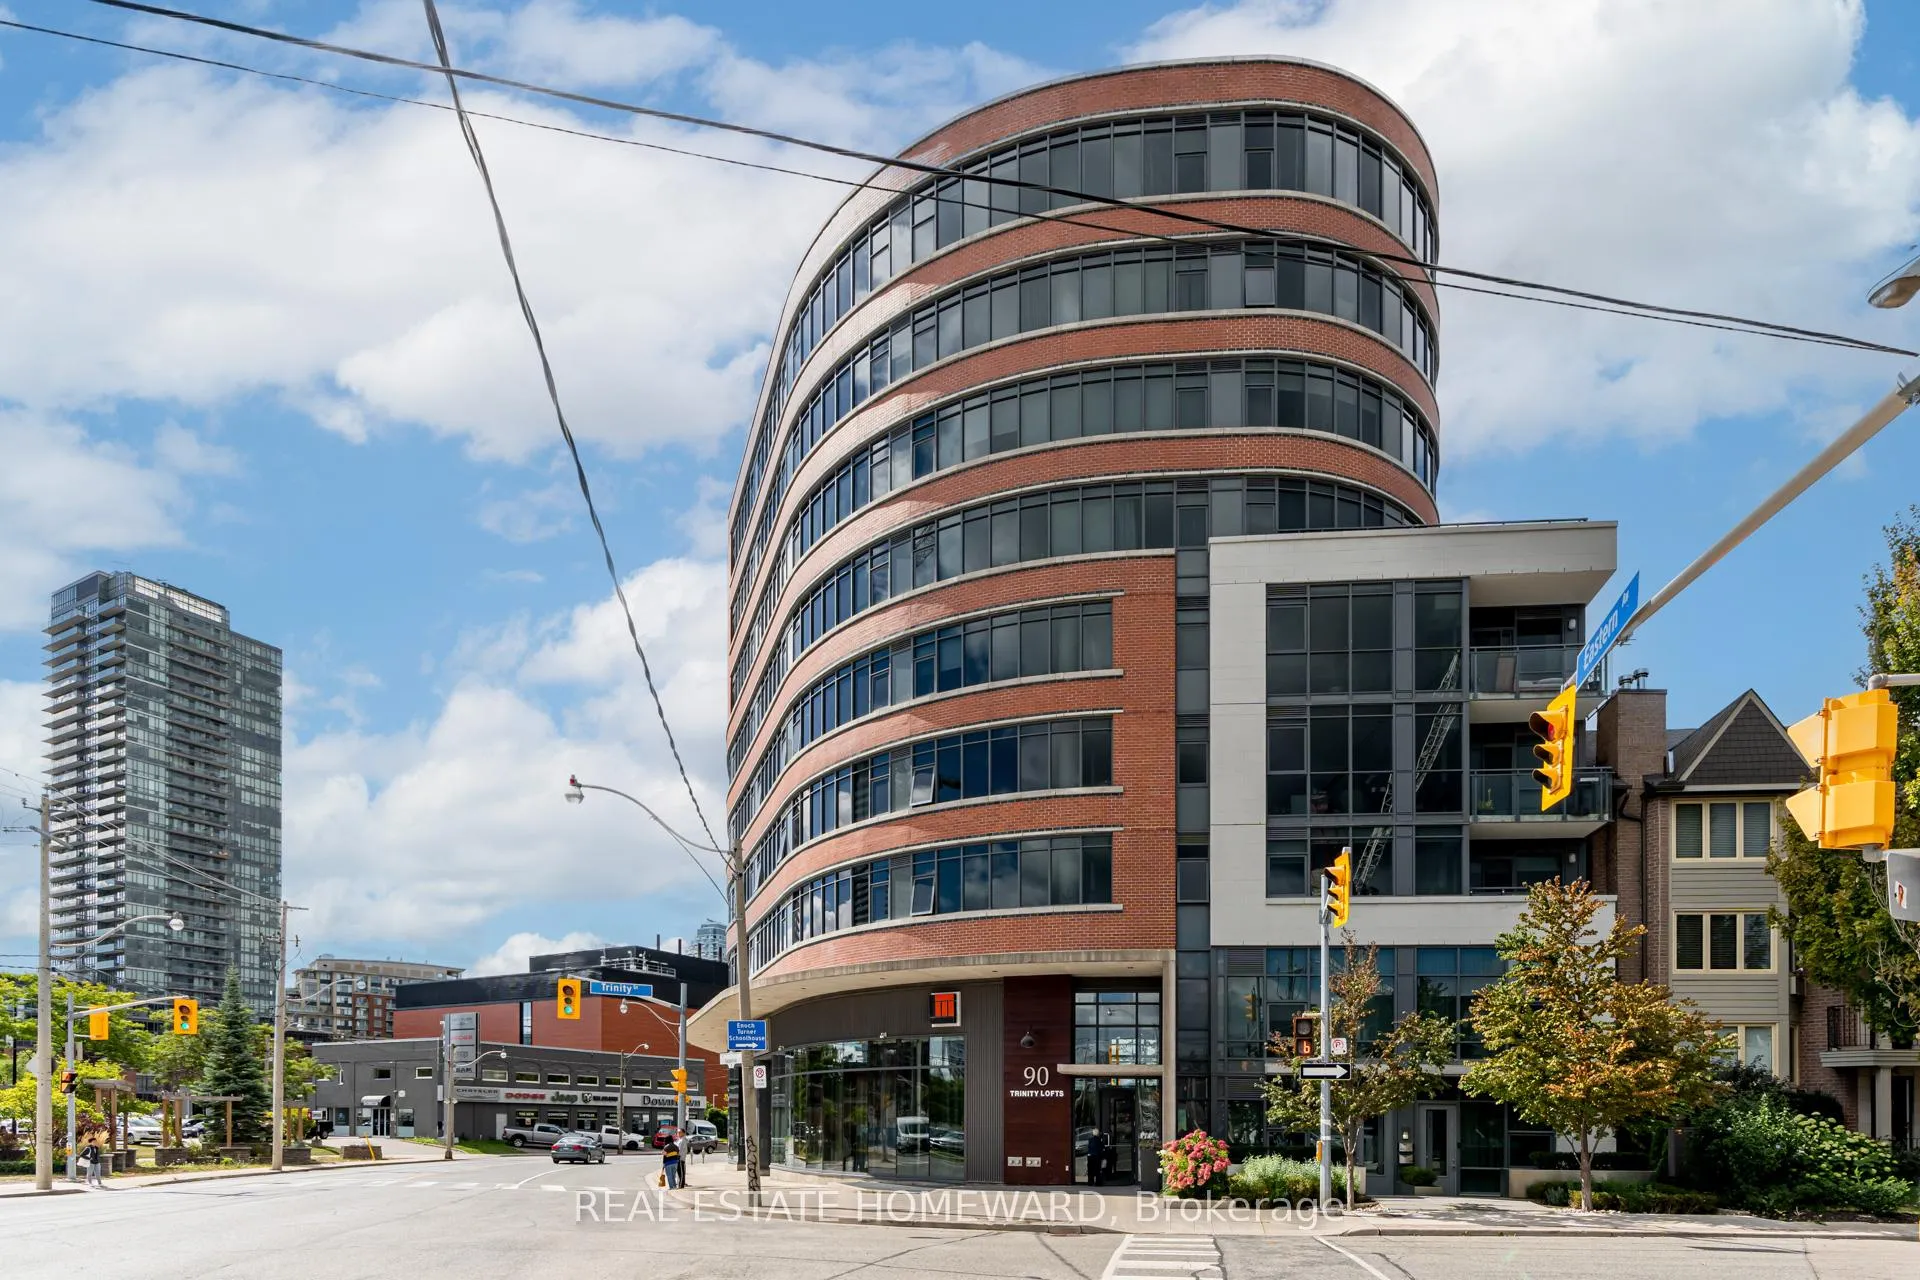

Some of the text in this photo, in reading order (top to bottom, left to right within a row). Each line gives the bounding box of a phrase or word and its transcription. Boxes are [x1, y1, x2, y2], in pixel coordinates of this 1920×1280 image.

[1583, 609, 1618, 671] Eastern
[601, 982, 632, 995] Trinity
[1023, 1066, 1050, 1087] 90
[504, 1092, 546, 1100] DODGE
[551, 1091, 578, 1103] Jeep
[1009, 1089, 1065, 1098] TRINITY LOFTS
